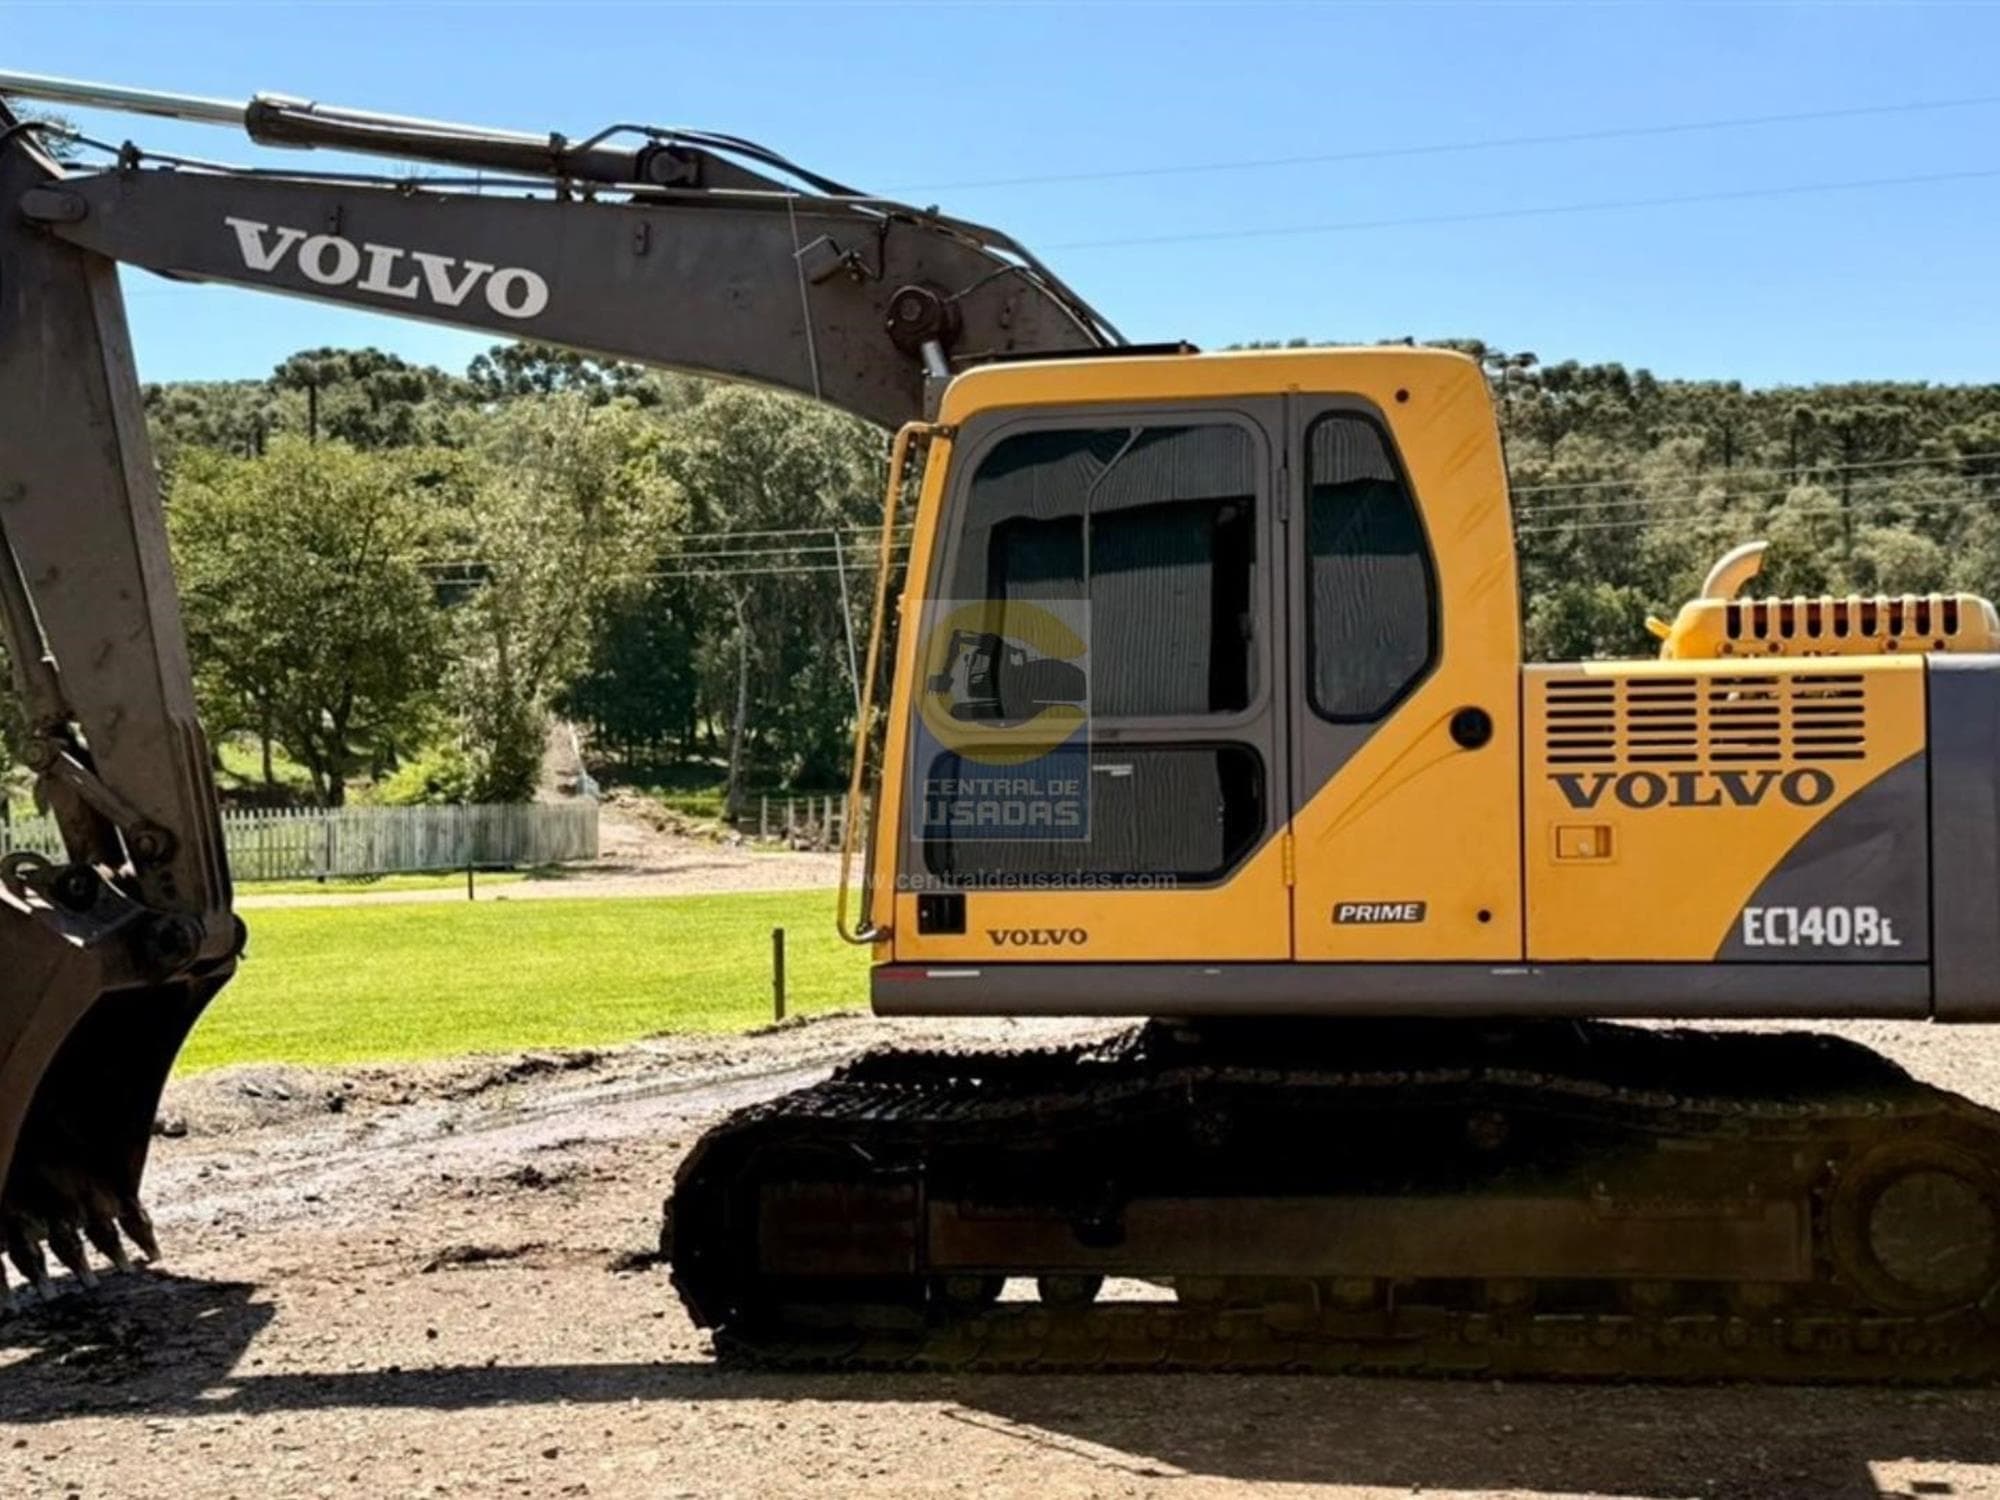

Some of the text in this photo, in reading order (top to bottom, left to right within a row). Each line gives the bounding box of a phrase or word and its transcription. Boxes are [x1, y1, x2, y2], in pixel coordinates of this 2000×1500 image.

[225, 216, 549, 318] VOLVO
[1547, 768, 1835, 808] VOLVO
[1338, 903, 1419, 922] PRIME
[985, 928, 1088, 947] VOLVO
